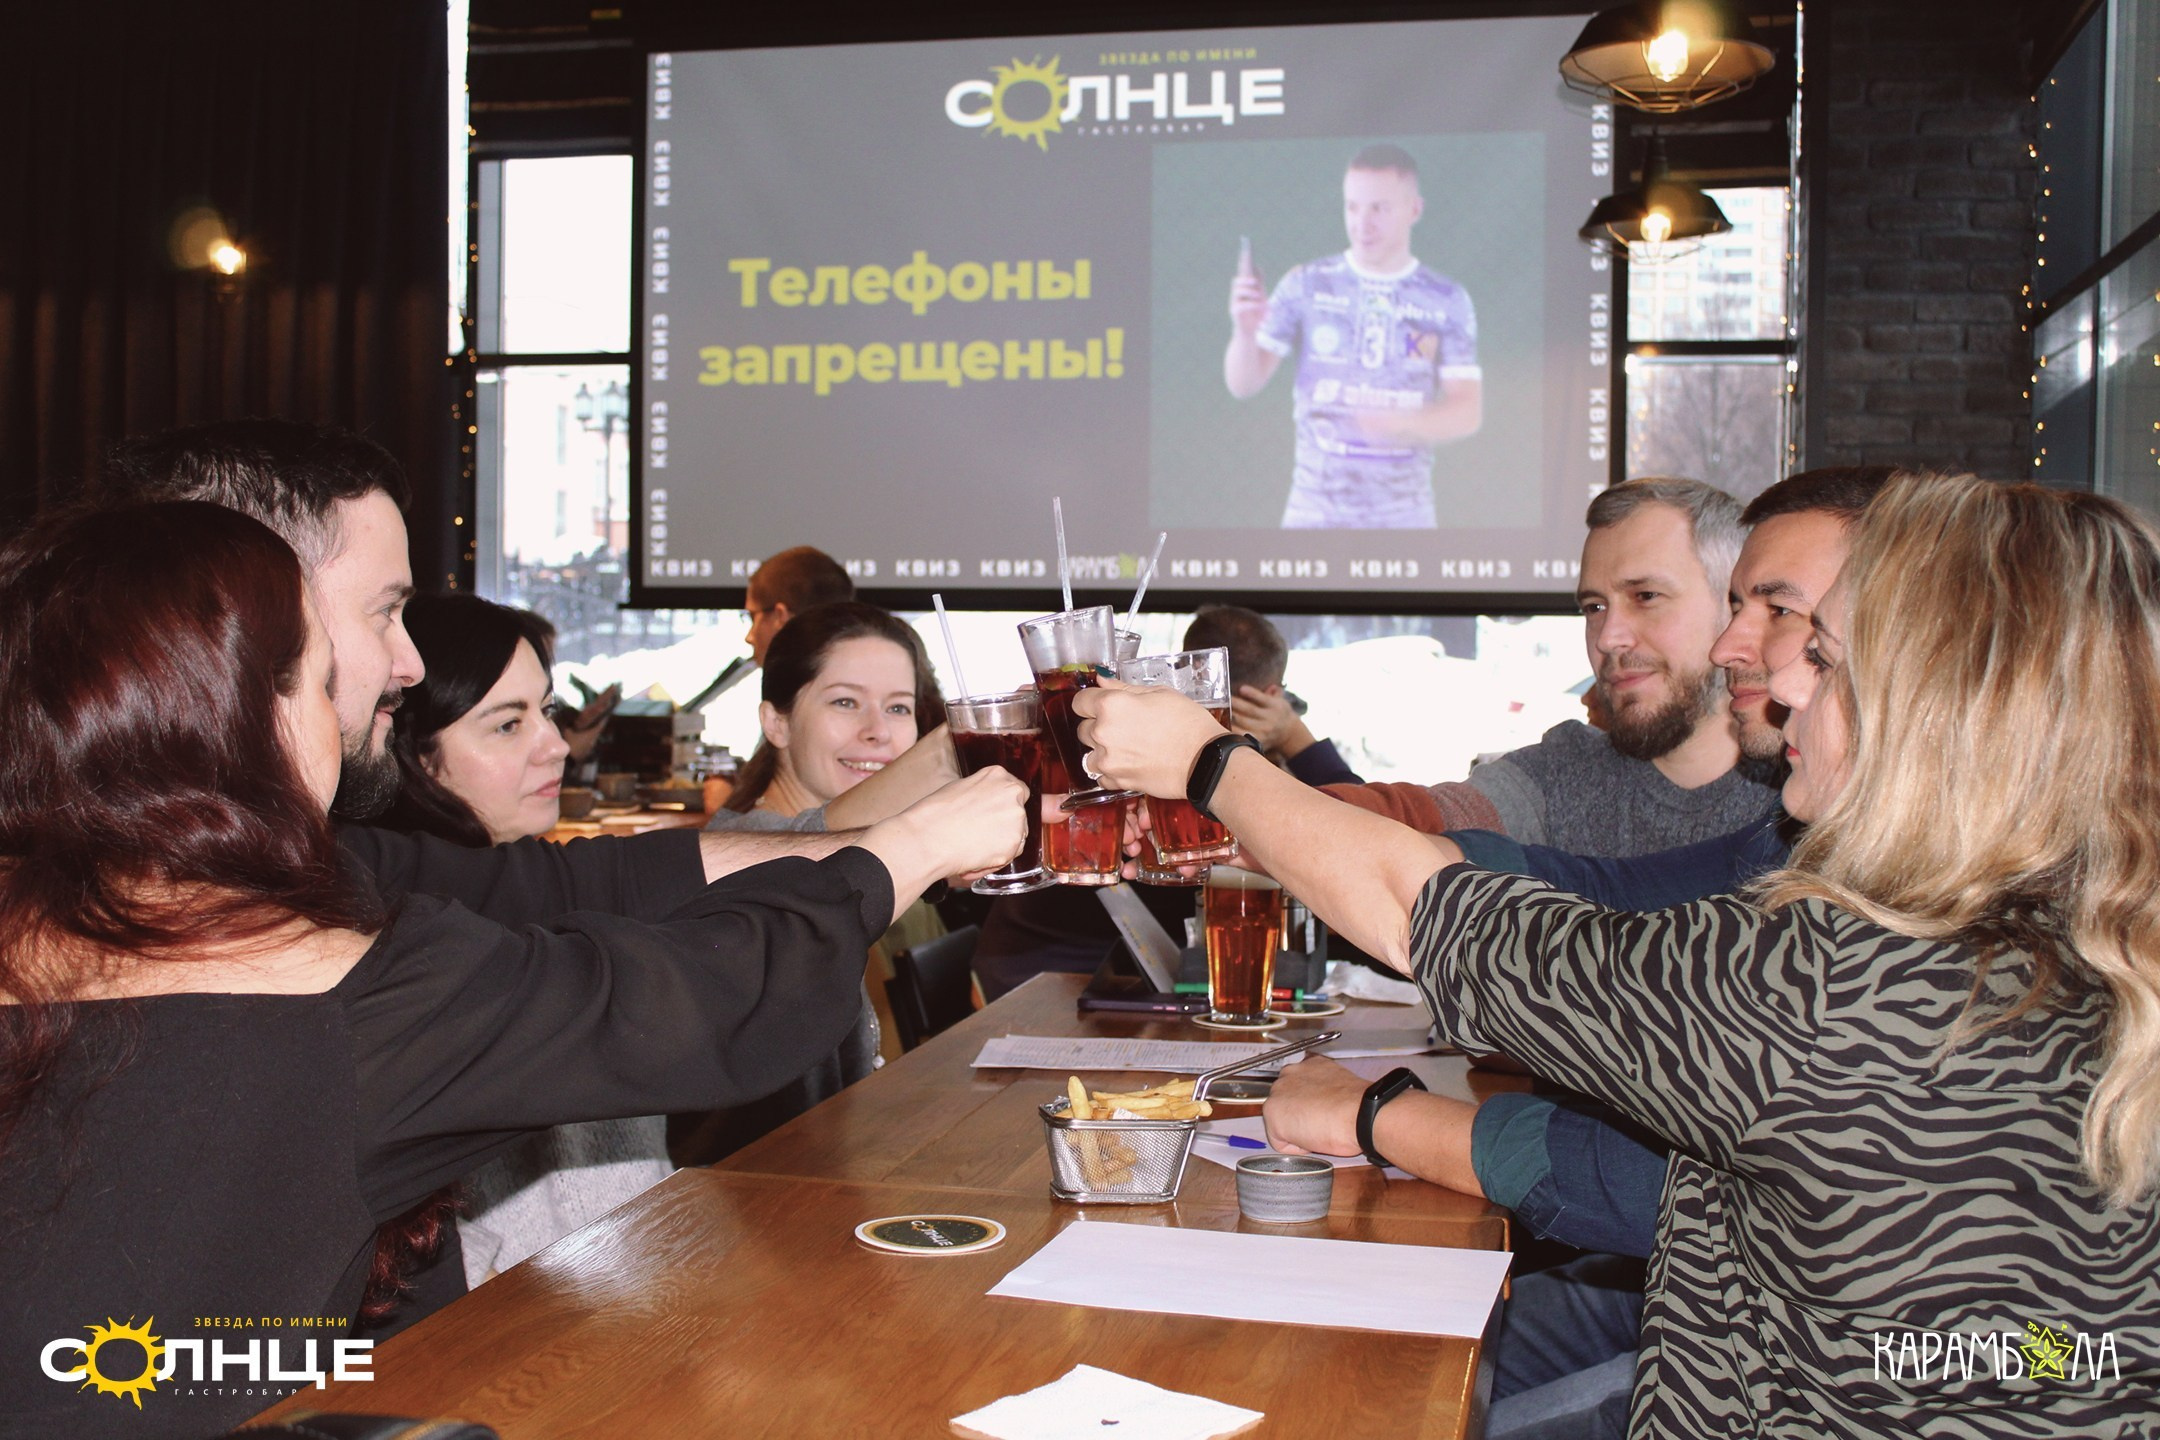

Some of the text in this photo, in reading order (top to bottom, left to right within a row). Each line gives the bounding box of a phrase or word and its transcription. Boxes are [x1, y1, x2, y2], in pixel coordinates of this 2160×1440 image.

[654, 53, 672, 119] КВИЗ
[944, 58, 1285, 144] СОЛНЦЕ
[653, 140, 671, 206] КВИЗ
[1591, 104, 1609, 176] КВИЗ
[652, 226, 670, 293] КВИЗ
[728, 251, 1091, 315] Телефоны
[651, 313, 669, 381] КВИЗ
[698, 328, 1125, 395] запрещены!
[1589, 294, 1608, 366] КВИЗ
[650, 401, 668, 468] КВИЗ
[1588, 388, 1607, 461] КВИЗ
[650, 488, 668, 556] КВИЗ
[650, 560, 713, 577] КВИЗ
[895, 559, 961, 577] КВИЗ
[980, 559, 1046, 577] КВИЗ
[1171, 559, 1239, 577] КВИЗ
[1259, 559, 1328, 577] КВИЗ
[1350, 560, 1419, 578] КВИЗ
[1441, 560, 1511, 578] КВИЗ
[1533, 560, 1581, 578] КВИ
